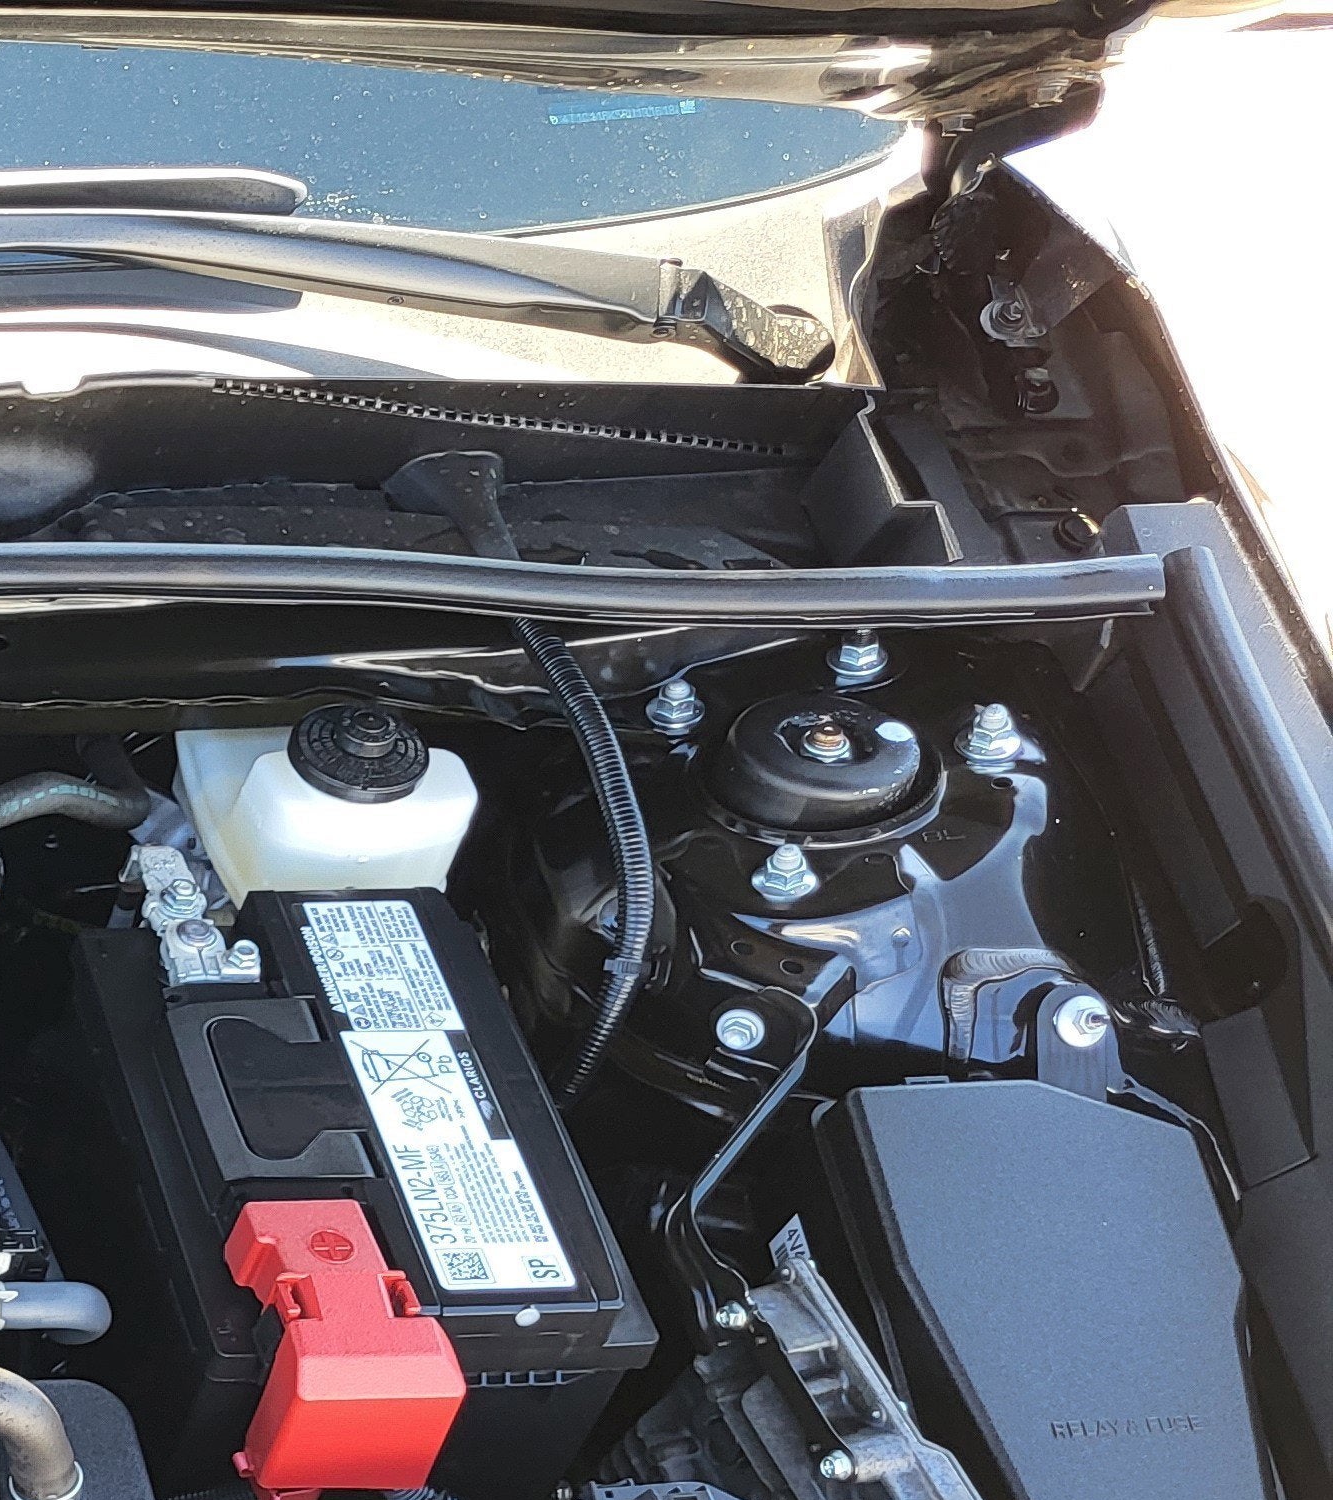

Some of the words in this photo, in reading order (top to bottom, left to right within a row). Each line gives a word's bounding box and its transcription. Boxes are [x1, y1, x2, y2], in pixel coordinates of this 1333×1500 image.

[436, 1055, 456, 1076] Pb
[457, 1051, 487, 1100] CLARIOS
[392, 1144, 457, 1245] 375LN2-MF
[528, 1258, 560, 1279] SP
[1050, 1419, 1119, 1440] RELAY
[1144, 1414, 1206, 1434] FUSE
